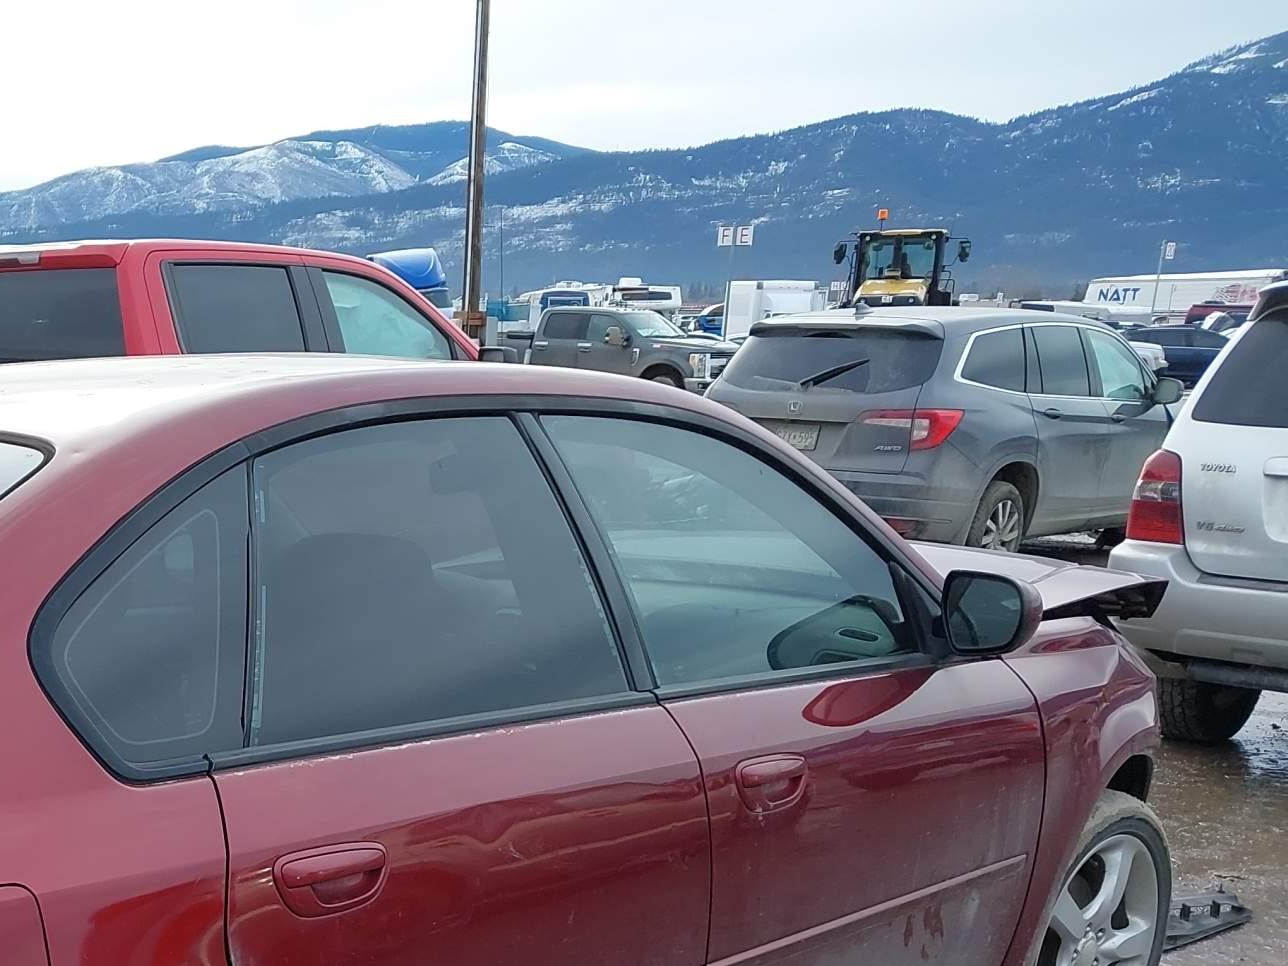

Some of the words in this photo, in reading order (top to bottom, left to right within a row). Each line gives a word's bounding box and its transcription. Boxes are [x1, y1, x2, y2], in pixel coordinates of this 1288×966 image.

[722, 228, 731, 244] F
[740, 227, 749, 244] E
[1097, 288, 1141, 305] NATT
[873, 444, 903, 452] AWD
[1200, 463, 1238, 473] TOYOTA
